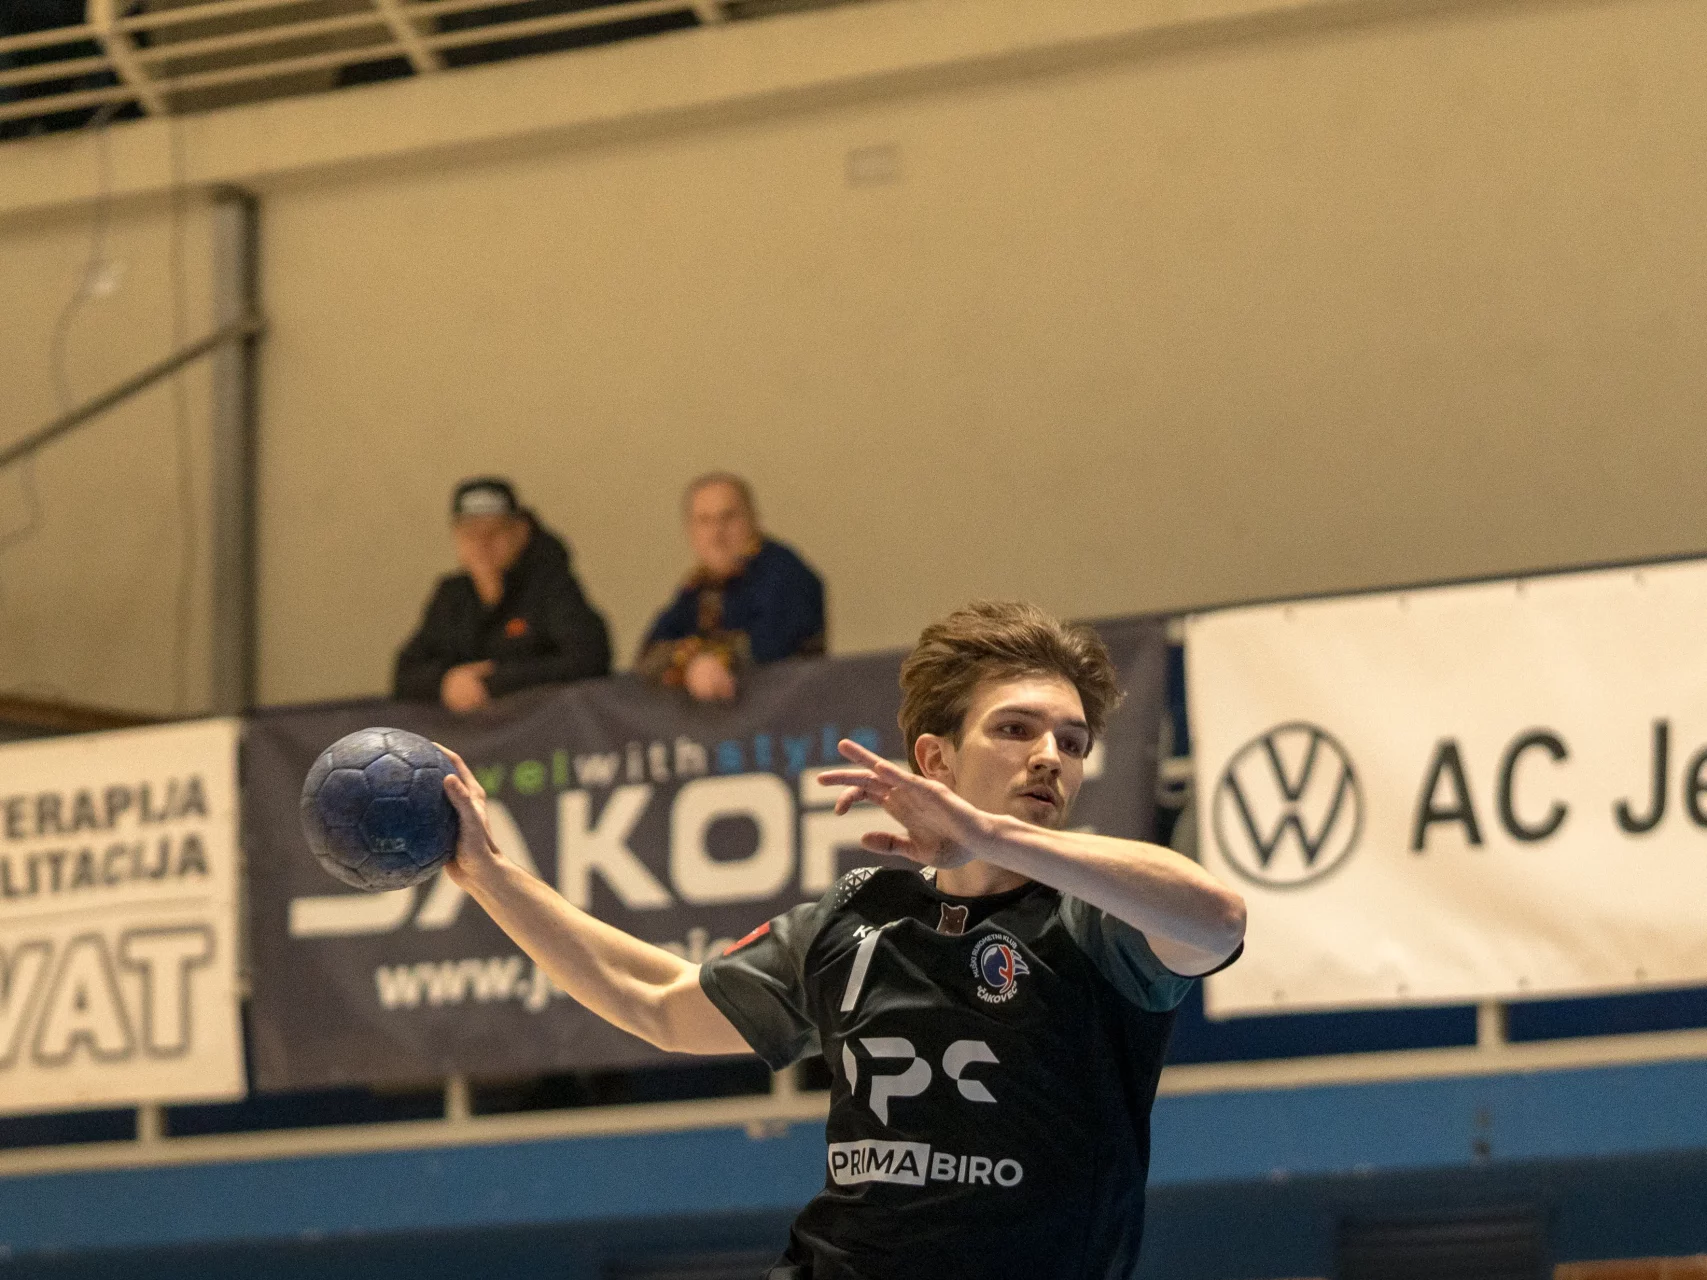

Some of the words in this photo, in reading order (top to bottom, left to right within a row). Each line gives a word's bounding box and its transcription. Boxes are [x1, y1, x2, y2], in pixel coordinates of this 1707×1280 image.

[0, 773, 209, 841] ERAPIJA
[1411, 727, 1570, 852] AC
[1002, 934, 1018, 950] KLUB
[929, 1151, 1024, 1188] BIRO
